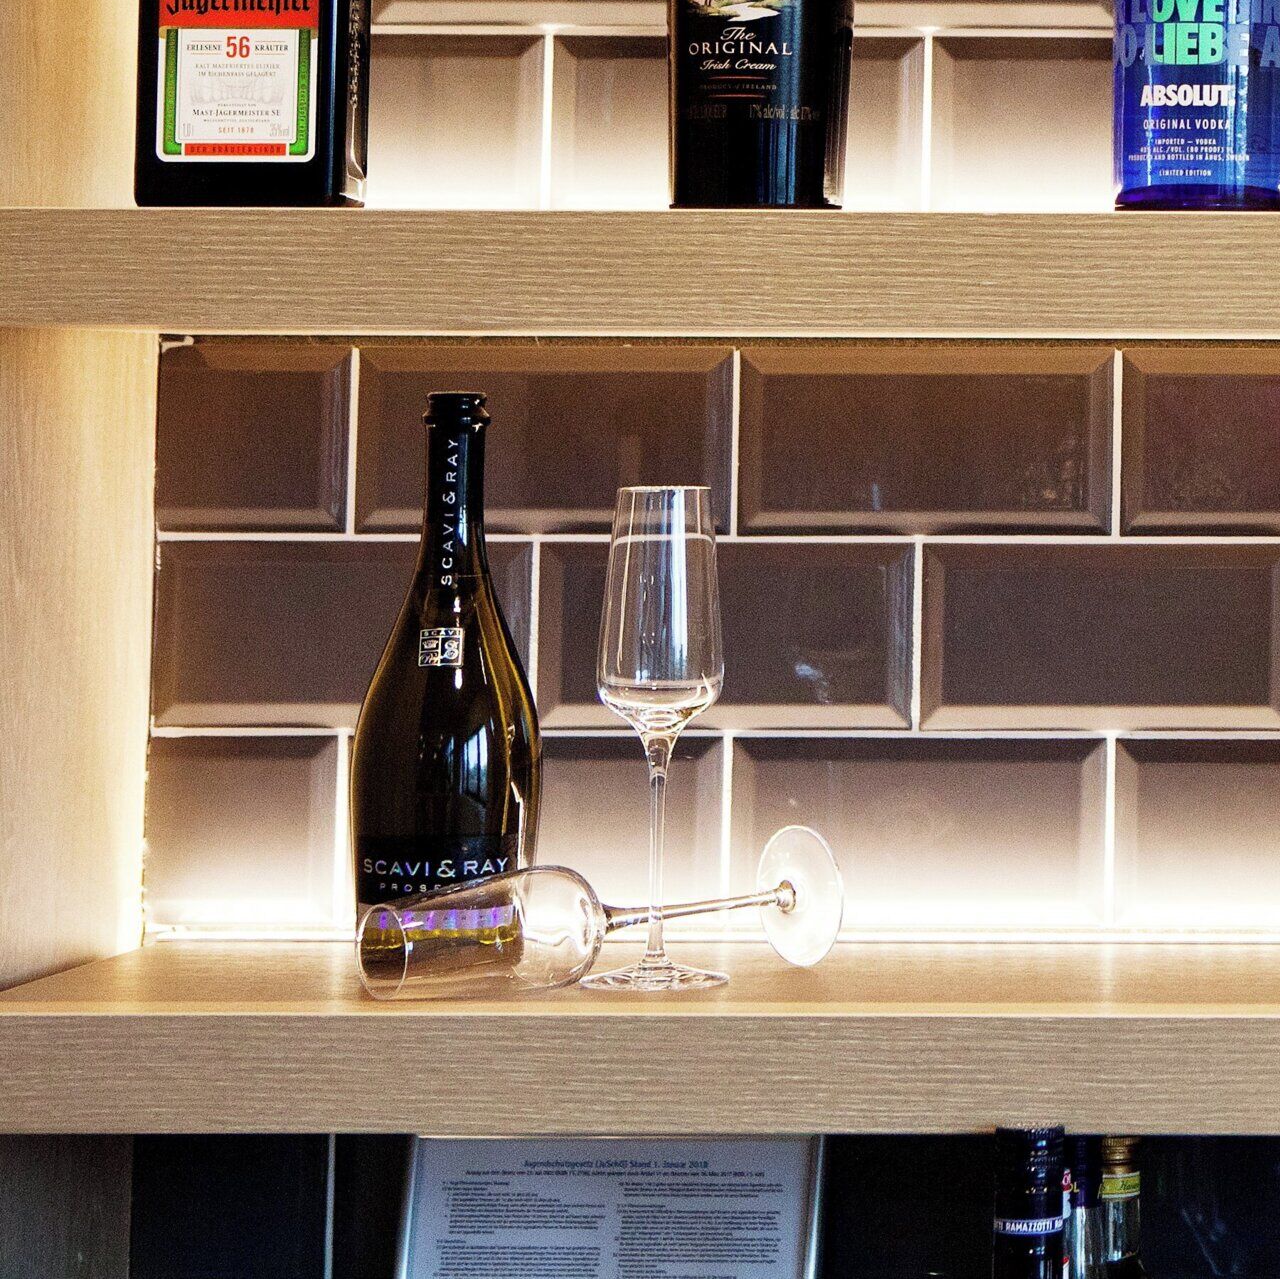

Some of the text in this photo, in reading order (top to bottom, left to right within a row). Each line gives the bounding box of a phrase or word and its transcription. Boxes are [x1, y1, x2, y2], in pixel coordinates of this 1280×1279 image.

[720, 26, 757, 40] The
[226, 36, 250, 58] 56
[255, 43, 289, 51] KRÄUTER
[688, 41, 793, 56] ORIGINAL
[1145, 22, 1251, 67] LIEBE
[700, 58, 777, 71] Irish Cream
[1142, 118, 1233, 131] ORIGINAL VODKA
[1154, 138, 1217, 146] IMPORTED VODKA
[1158, 169, 1212, 177] LIMITED EDITION
[441, 439, 459, 586] SCAVI & RAY
[363, 857, 509, 878] SCAVI & RAY
[1006, 1219, 1053, 1232] RAMAZZOTTI
